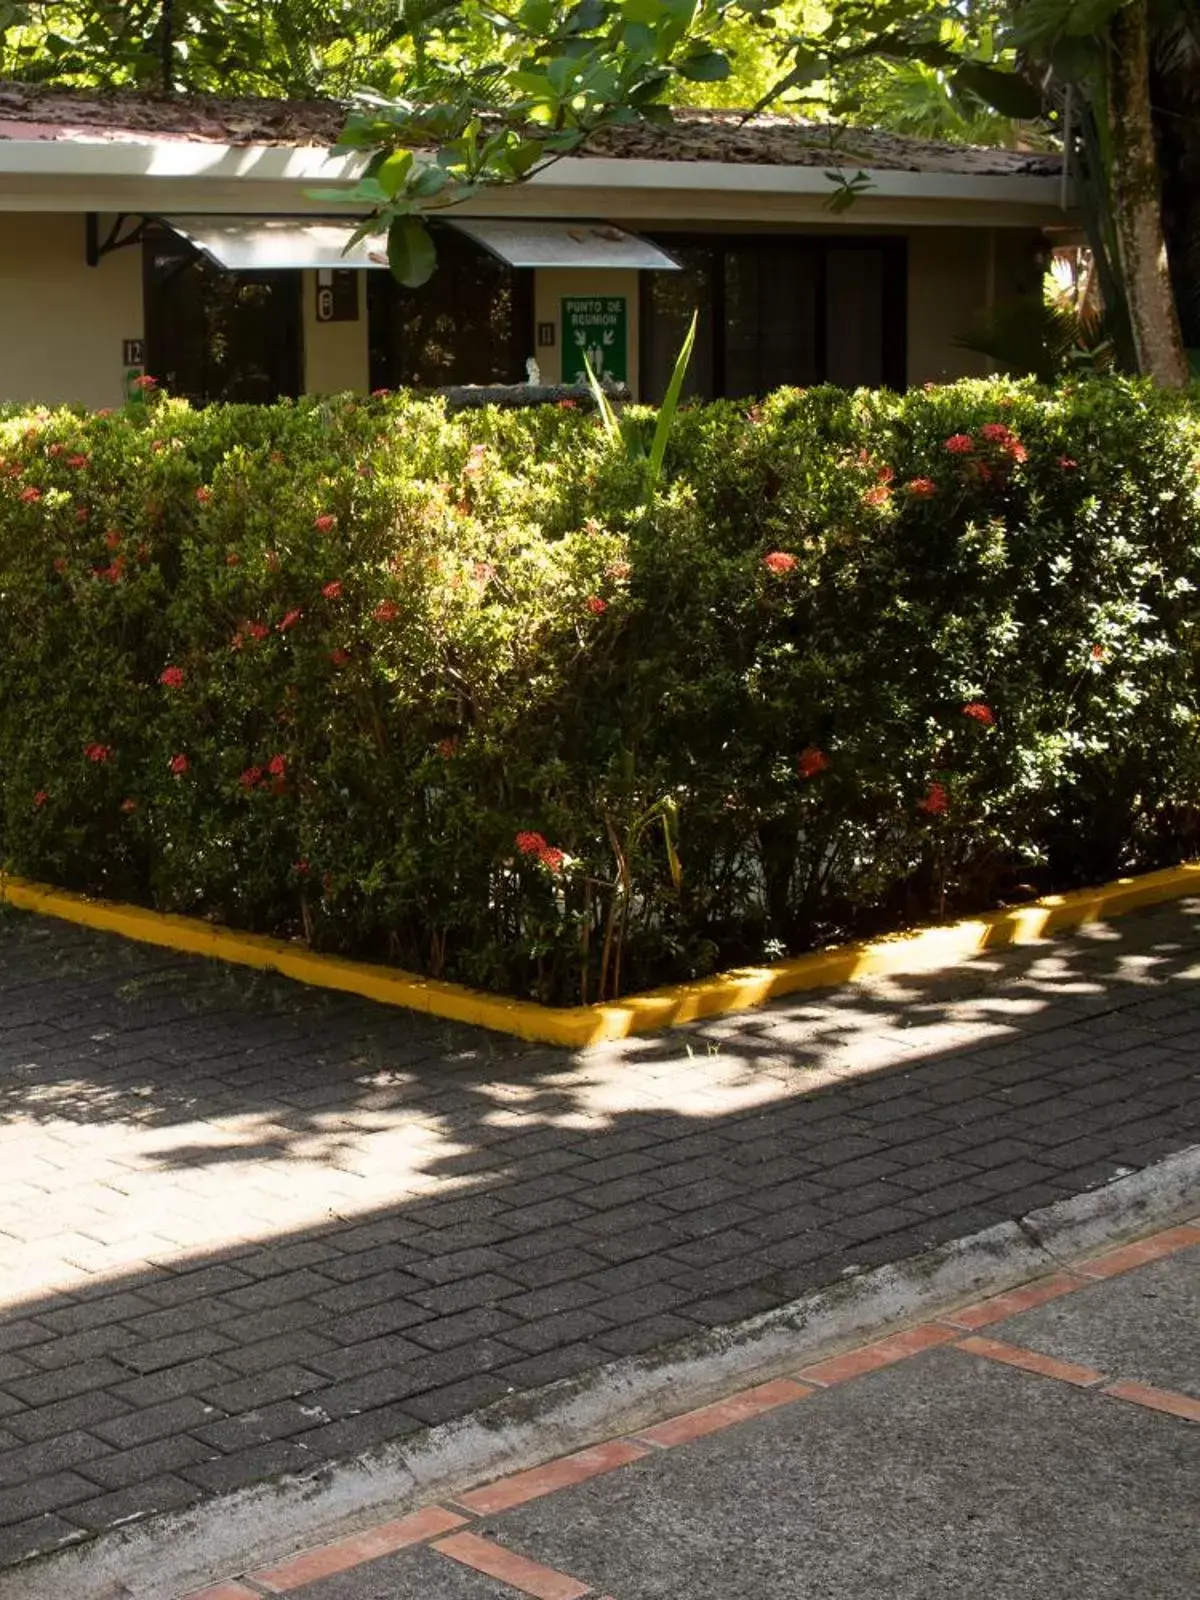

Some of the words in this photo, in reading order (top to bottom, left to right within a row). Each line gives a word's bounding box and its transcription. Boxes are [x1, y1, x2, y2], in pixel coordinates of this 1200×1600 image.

[566, 301, 602, 313] PUNTO
[607, 301, 623, 312] DE
[128, 342, 141, 362] 12
